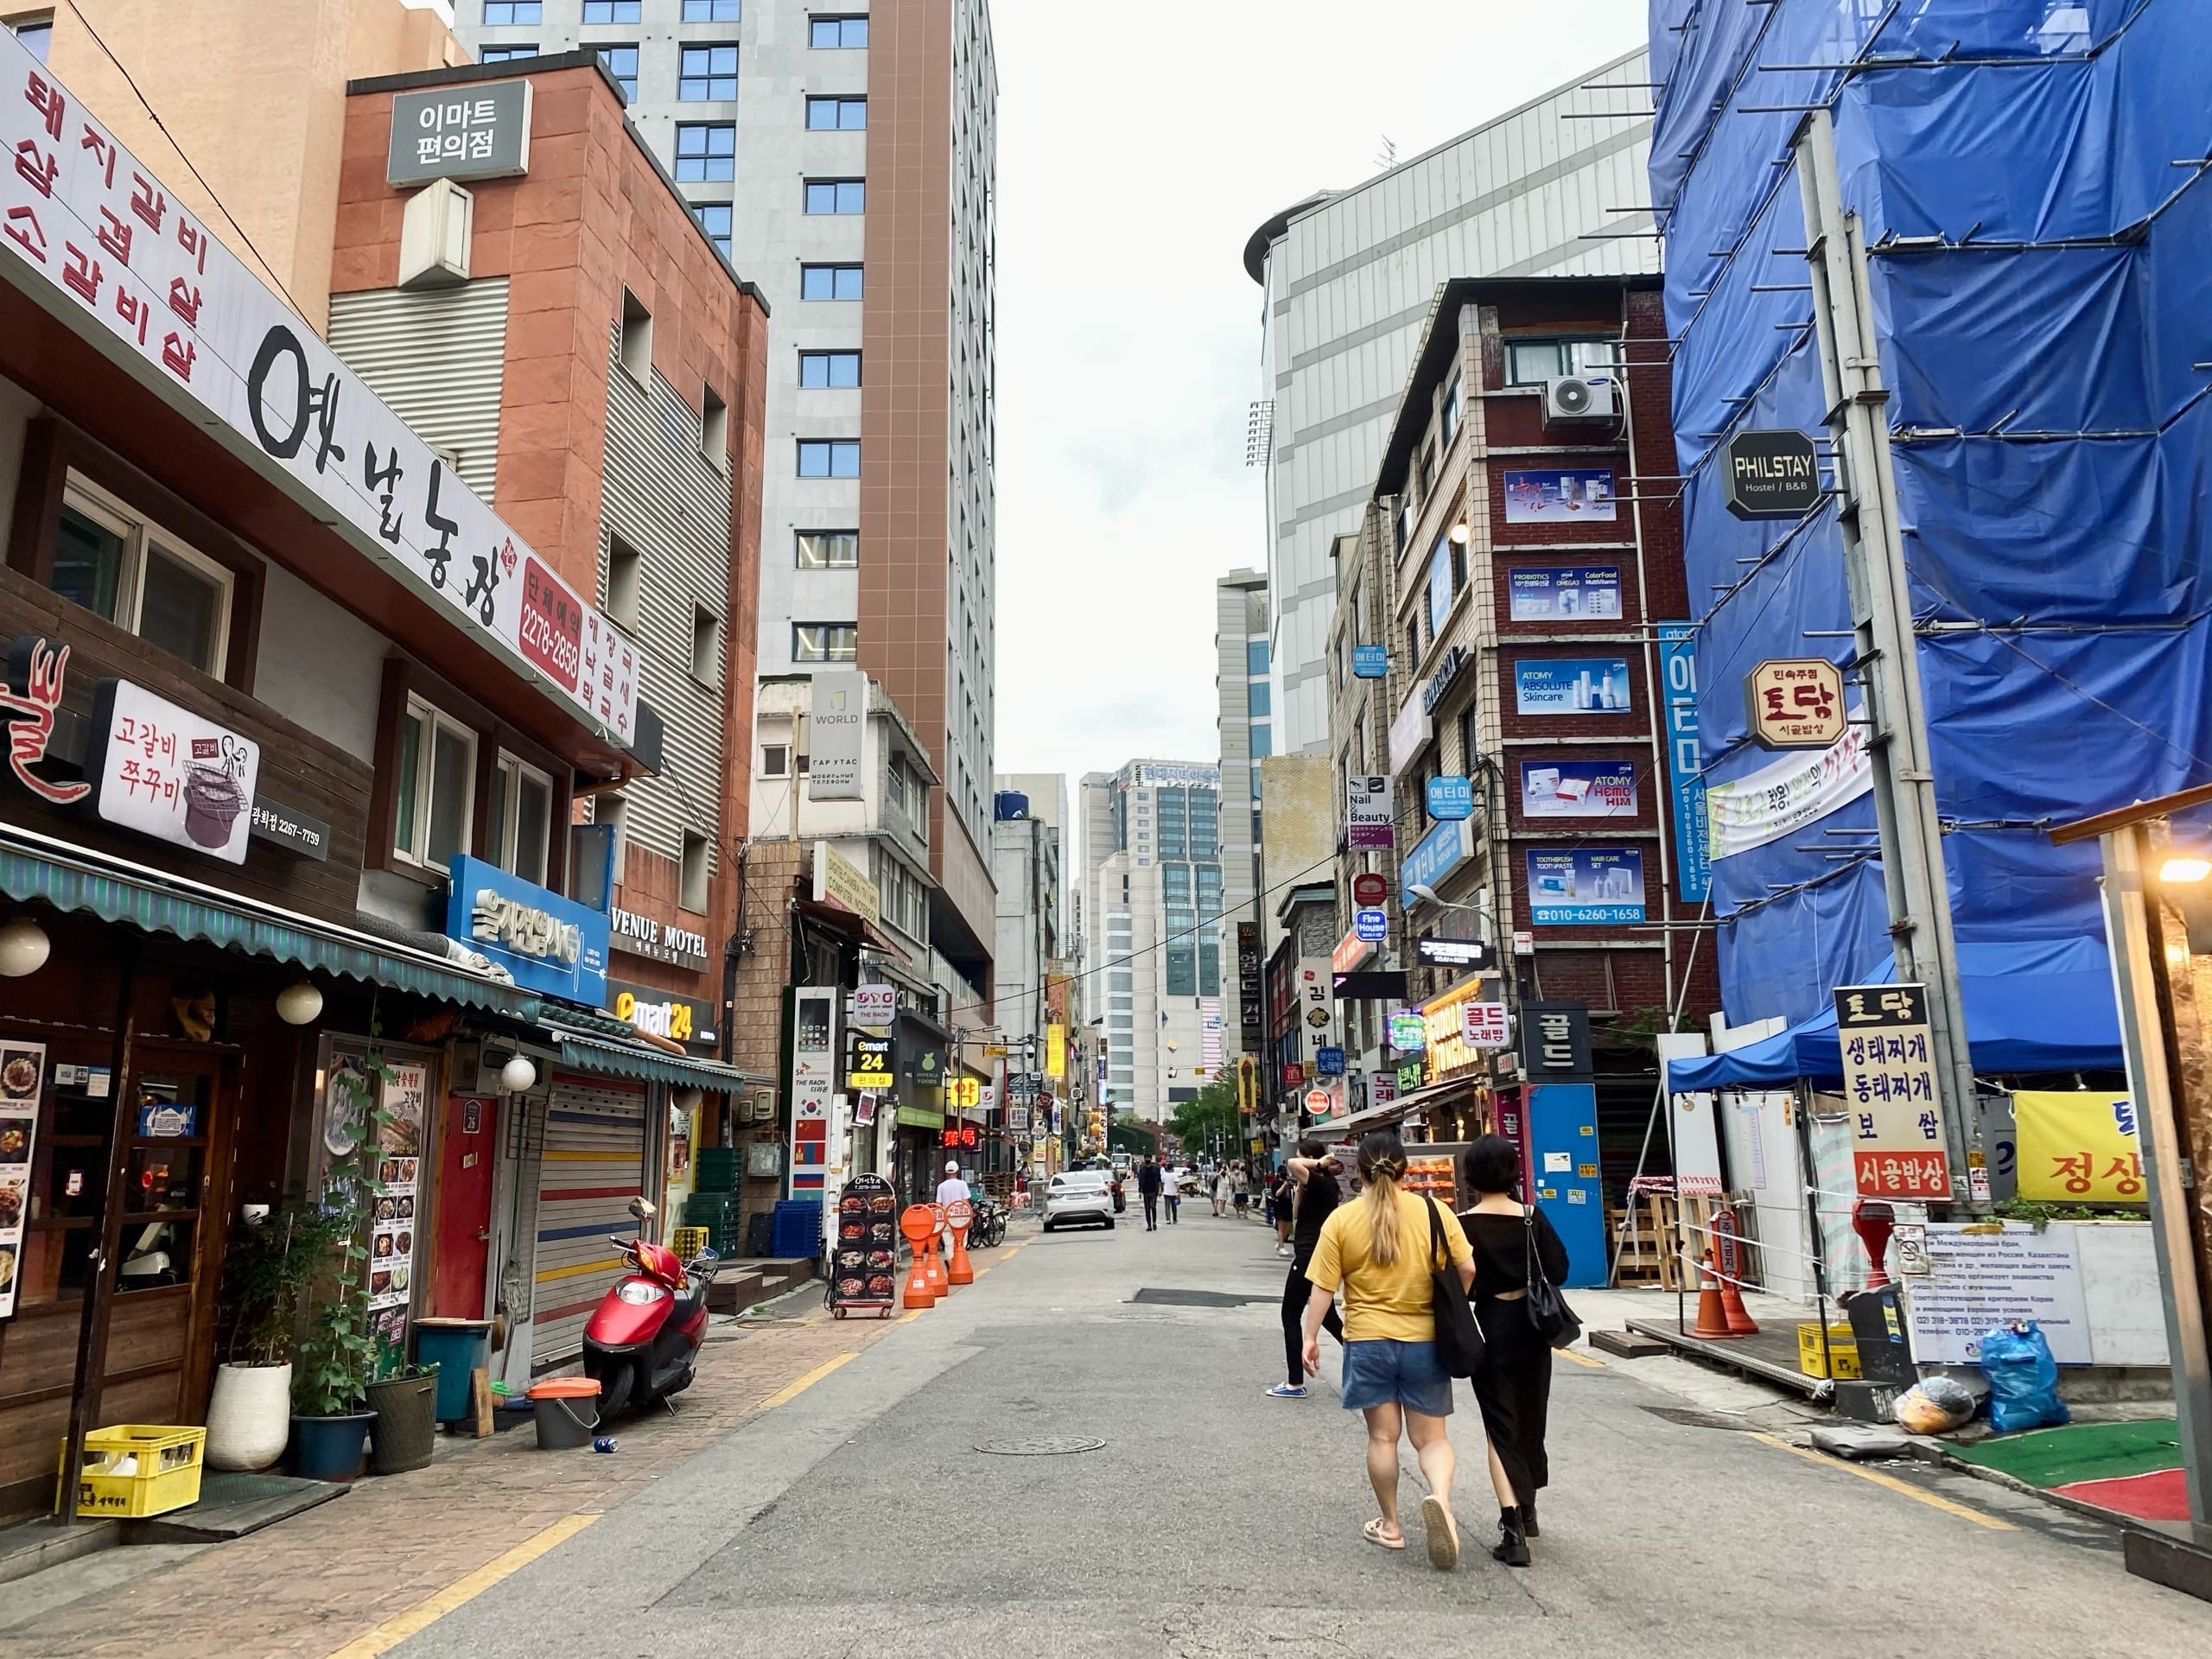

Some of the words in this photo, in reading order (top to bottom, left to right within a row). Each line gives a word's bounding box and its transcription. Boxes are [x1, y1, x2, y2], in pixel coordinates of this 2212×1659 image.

[418, 98, 497, 132] 이마트
[416, 130, 494, 166] 편의점
[24, 69, 207, 275] 돼지갈비
[14, 137, 204, 329] 삼겹살
[3, 205, 198, 382] 소갈비살
[1734, 454, 1812, 480] PHILSTAY
[1745, 480, 1776, 493] Hostel
[1785, 480, 1808, 492] B&B
[527, 573, 581, 640] 단체예약
[521, 602, 579, 680] 2278-2858
[588, 616, 632, 676] 해장국
[1355, 652, 1385, 663] 애터미
[1522, 671, 1553, 681] ATOMY
[1773, 668, 1818, 681] 민속주점
[1523, 681, 1573, 691] ABSOLUTE
[1523, 692, 1564, 702] Skincare
[1763, 683, 1836, 722] 토담
[816, 715, 858, 725] WORLD
[1778, 723, 1824, 736] 시골밥상
[114, 716, 178, 768] 고갈비
[1593, 776, 1631, 786] ATOMY
[1350, 794, 1371, 804] Nail
[1430, 785, 1471, 799] 애터미
[1350, 804, 1357, 813] &
[1605, 797, 1631, 807] HIM
[1350, 812, 1390, 824] Beauty
[277, 818, 321, 847] 2267-7759
[1363, 913, 1381, 924] Fine
[1550, 908, 1640, 921] 010-6260-1658
[1358, 923, 1385, 933] House
[664, 925, 708, 958] MOTEL
[1846, 990, 1916, 1022] 토담
[1467, 1007, 1504, 1027] 골드
[1469, 1029, 1504, 1043] 노래방
[858, 1040, 889, 1052] emart
[1846, 1033, 1929, 1068] 생태찌개
[861, 1052, 885, 1071] 24
[1319, 1061, 1343, 1073] 노래방
[858, 1076, 886, 1085] 편의점
[1852, 1071, 1933, 1104] 동태찌개
[954, 1081, 976, 1104] 약
[1374, 1075, 1395, 1106] 노래
[467, 1116, 476, 1129] 26
[1859, 1154, 1945, 1194] 시골밥상
